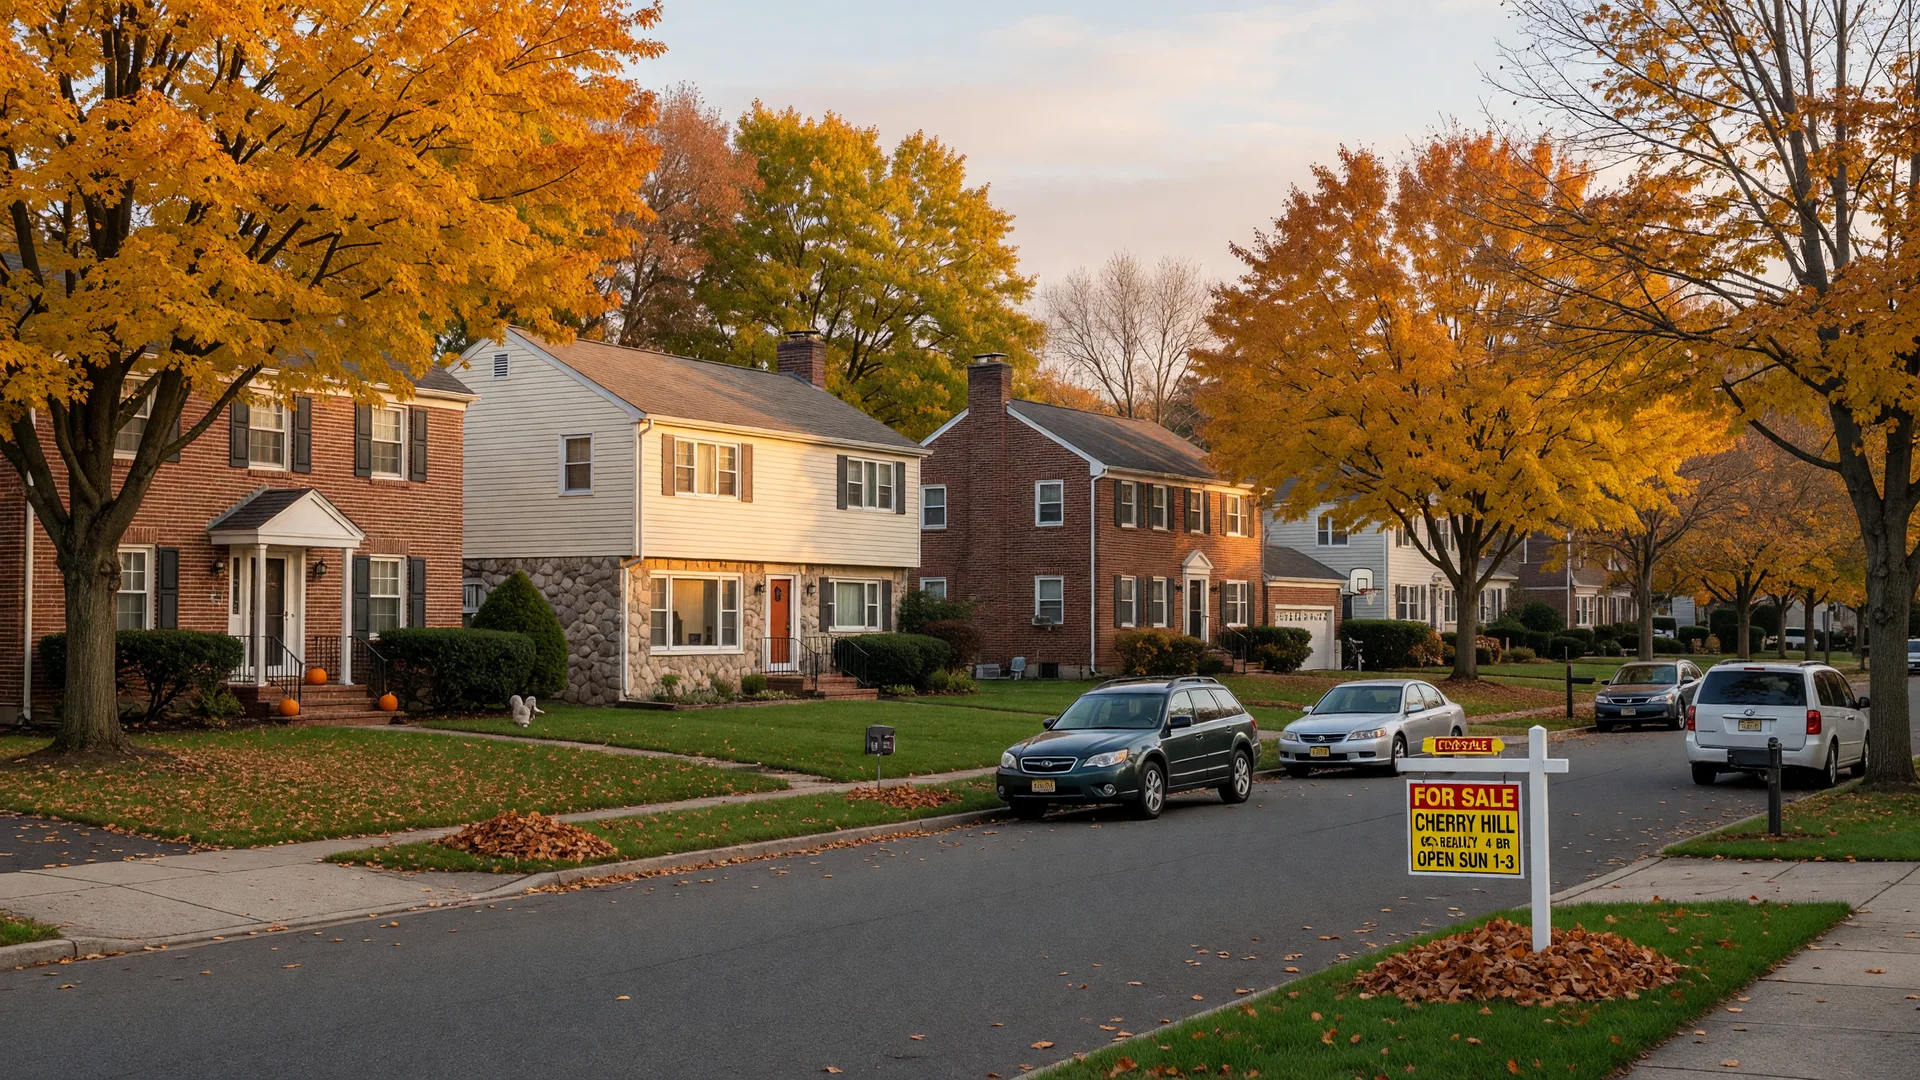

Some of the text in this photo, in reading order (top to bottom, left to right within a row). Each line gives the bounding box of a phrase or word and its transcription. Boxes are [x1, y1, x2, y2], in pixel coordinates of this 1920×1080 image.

[1414, 787, 1514, 808] FOR SALE
[1415, 812, 1515, 833] CHERRY HILL
[1485, 838, 1492, 849] 4
[1496, 838, 1511, 849] BR
[1417, 850, 1514, 869] OPEN SUN 1-3
